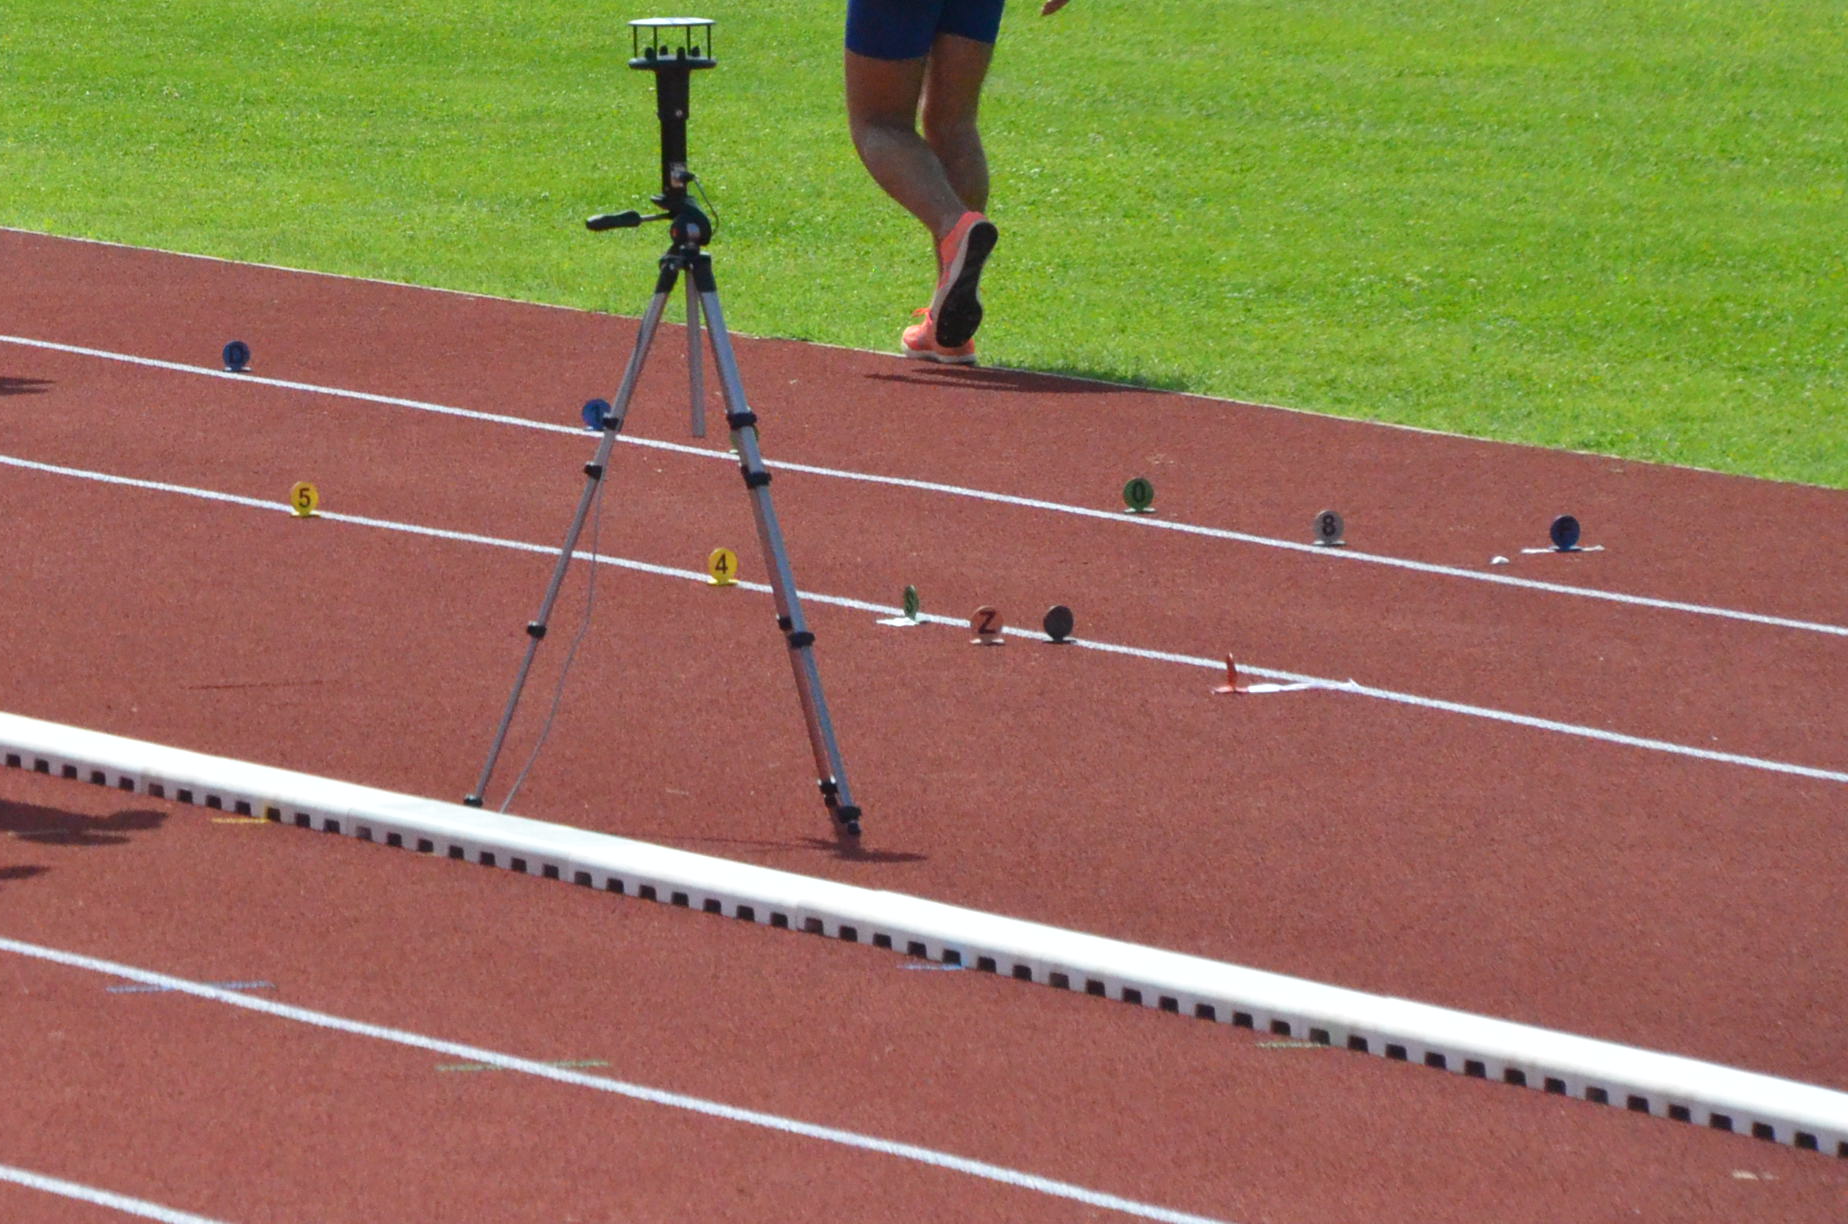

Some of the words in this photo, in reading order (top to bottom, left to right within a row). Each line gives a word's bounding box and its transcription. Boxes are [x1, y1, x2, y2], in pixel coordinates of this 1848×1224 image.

[299, 487, 311, 508] 5
[1322, 514, 1337, 536] 8
[714, 552, 729, 575] 4
